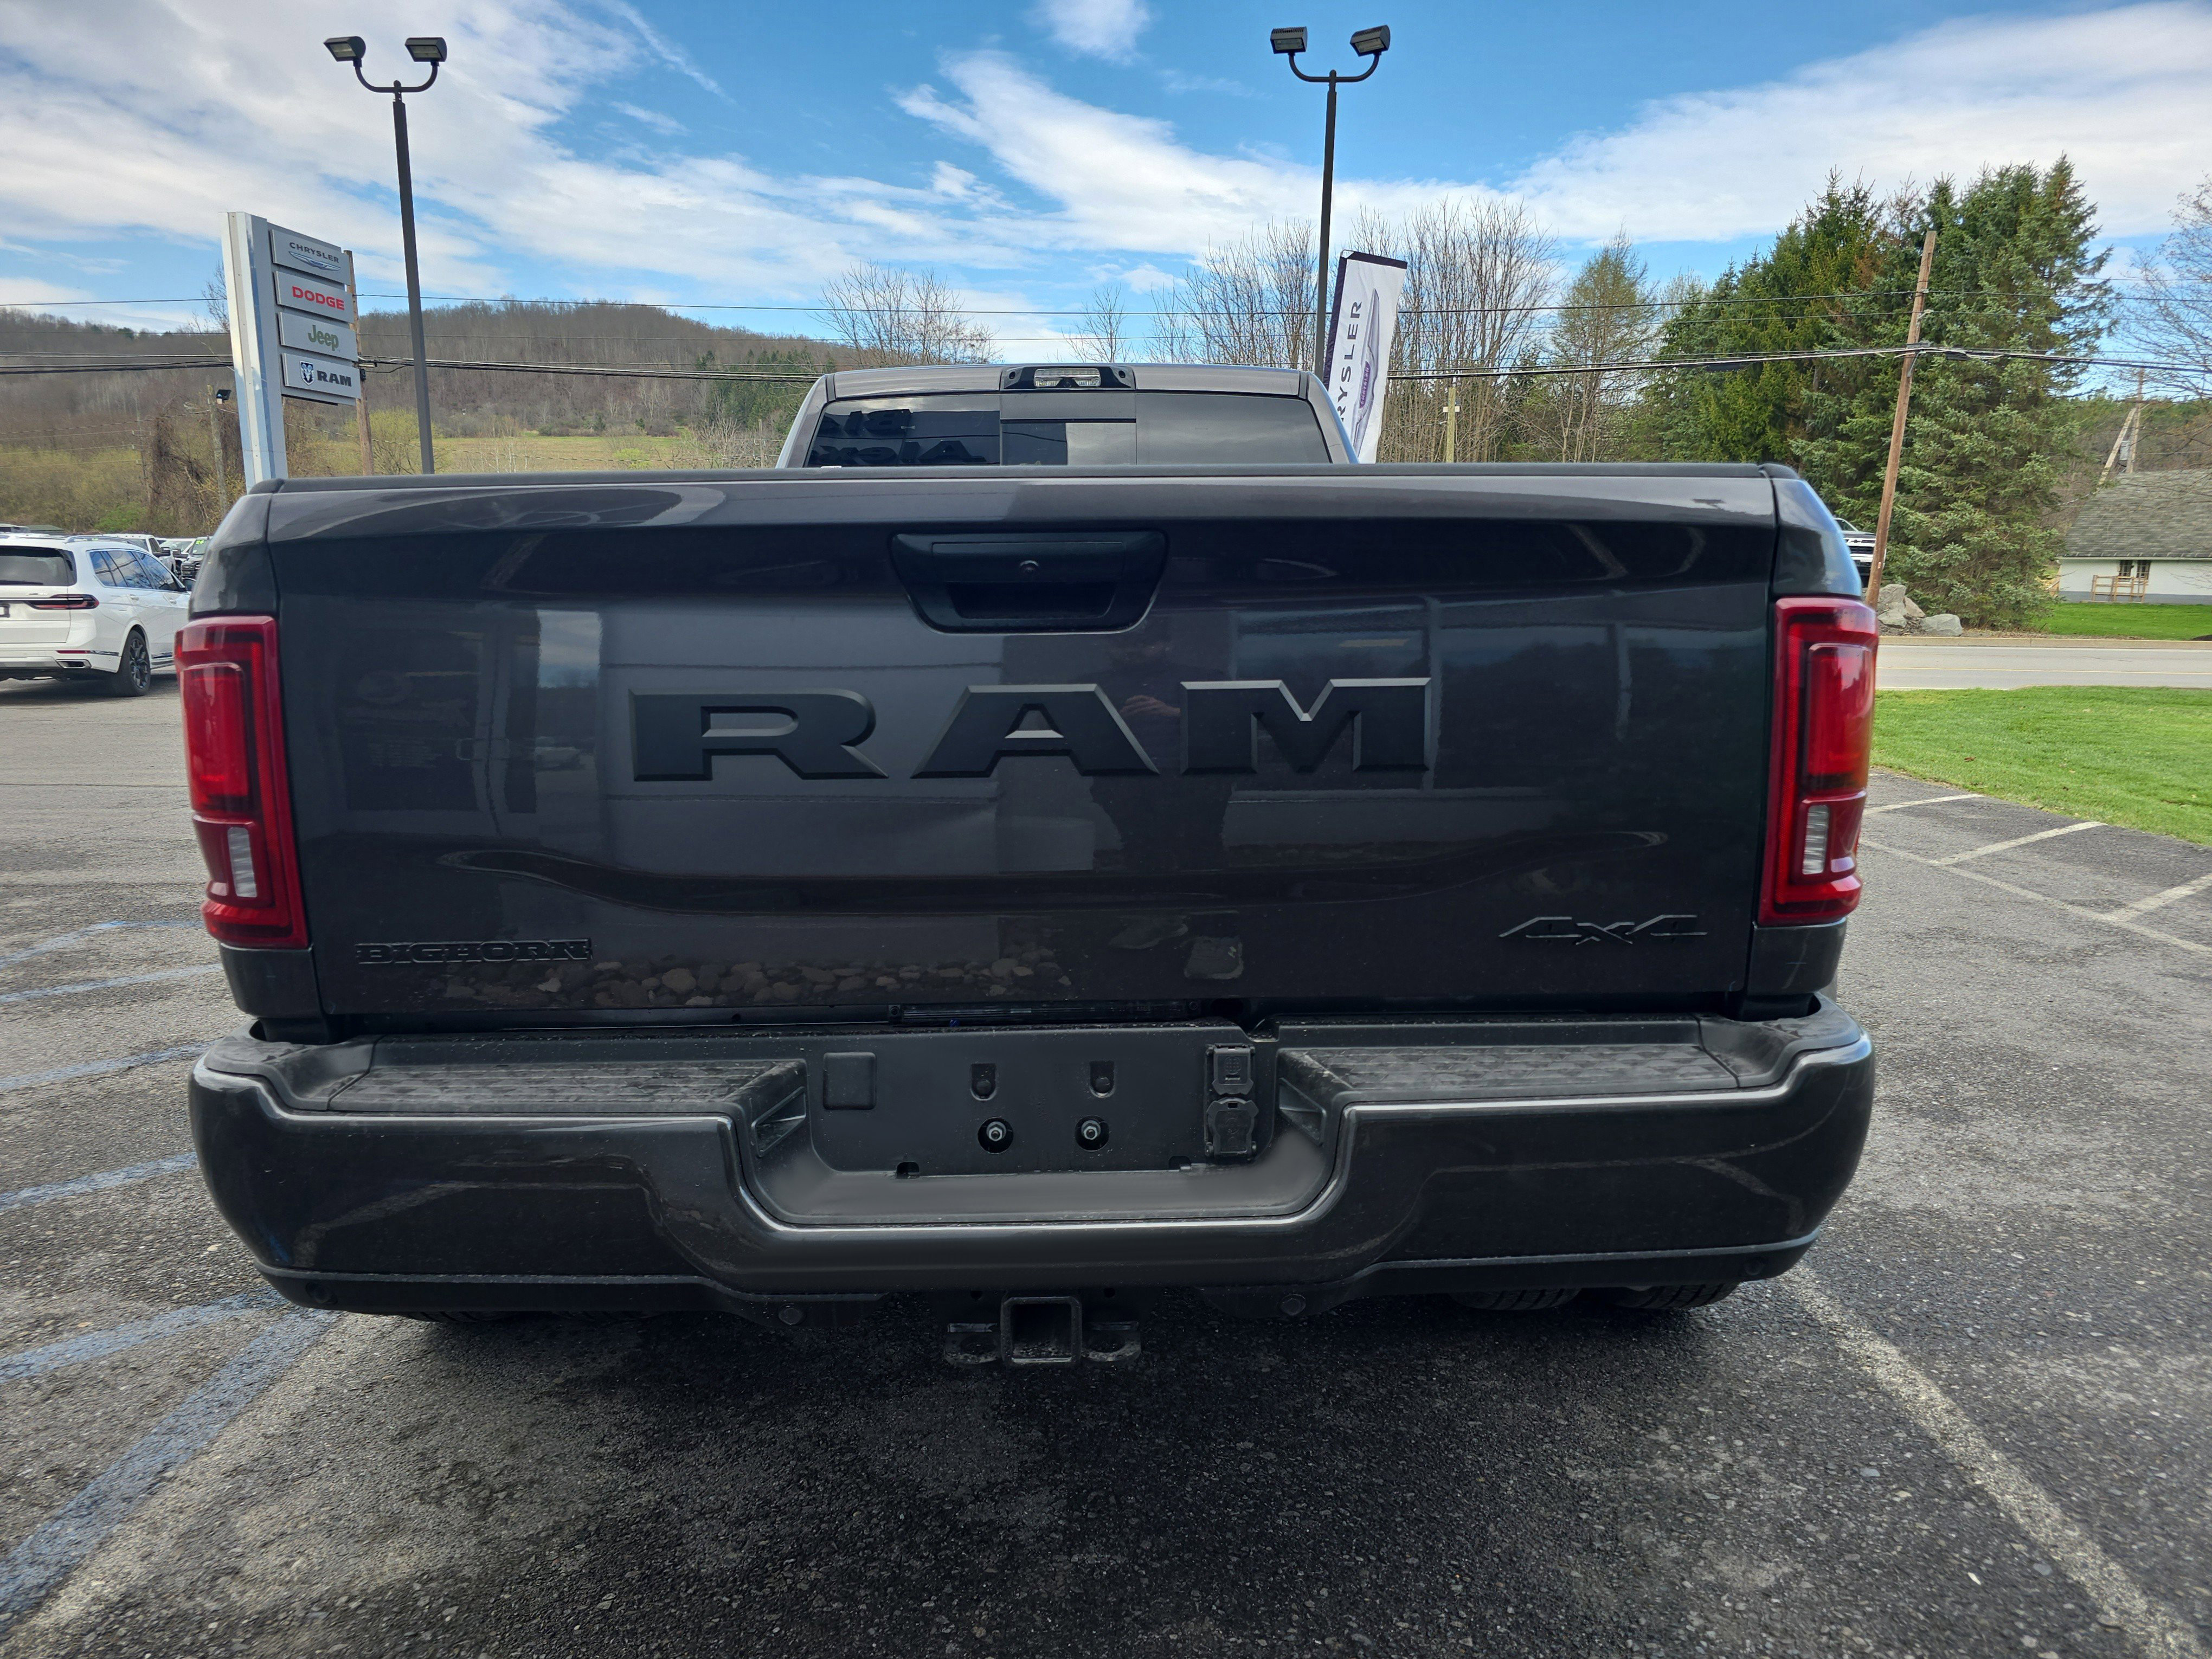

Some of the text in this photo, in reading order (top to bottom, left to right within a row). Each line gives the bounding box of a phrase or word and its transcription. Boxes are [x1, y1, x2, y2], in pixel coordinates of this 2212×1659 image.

[290, 242, 339, 263] CHRYSLER
[292, 286, 344, 311] DODGE
[307, 325, 339, 351] Jeep
[1337, 301, 1362, 422] RYSLER
[317, 370, 352, 387] RAM
[629, 677, 1431, 781] RAM
[355, 938, 592, 964] BIGHORN
